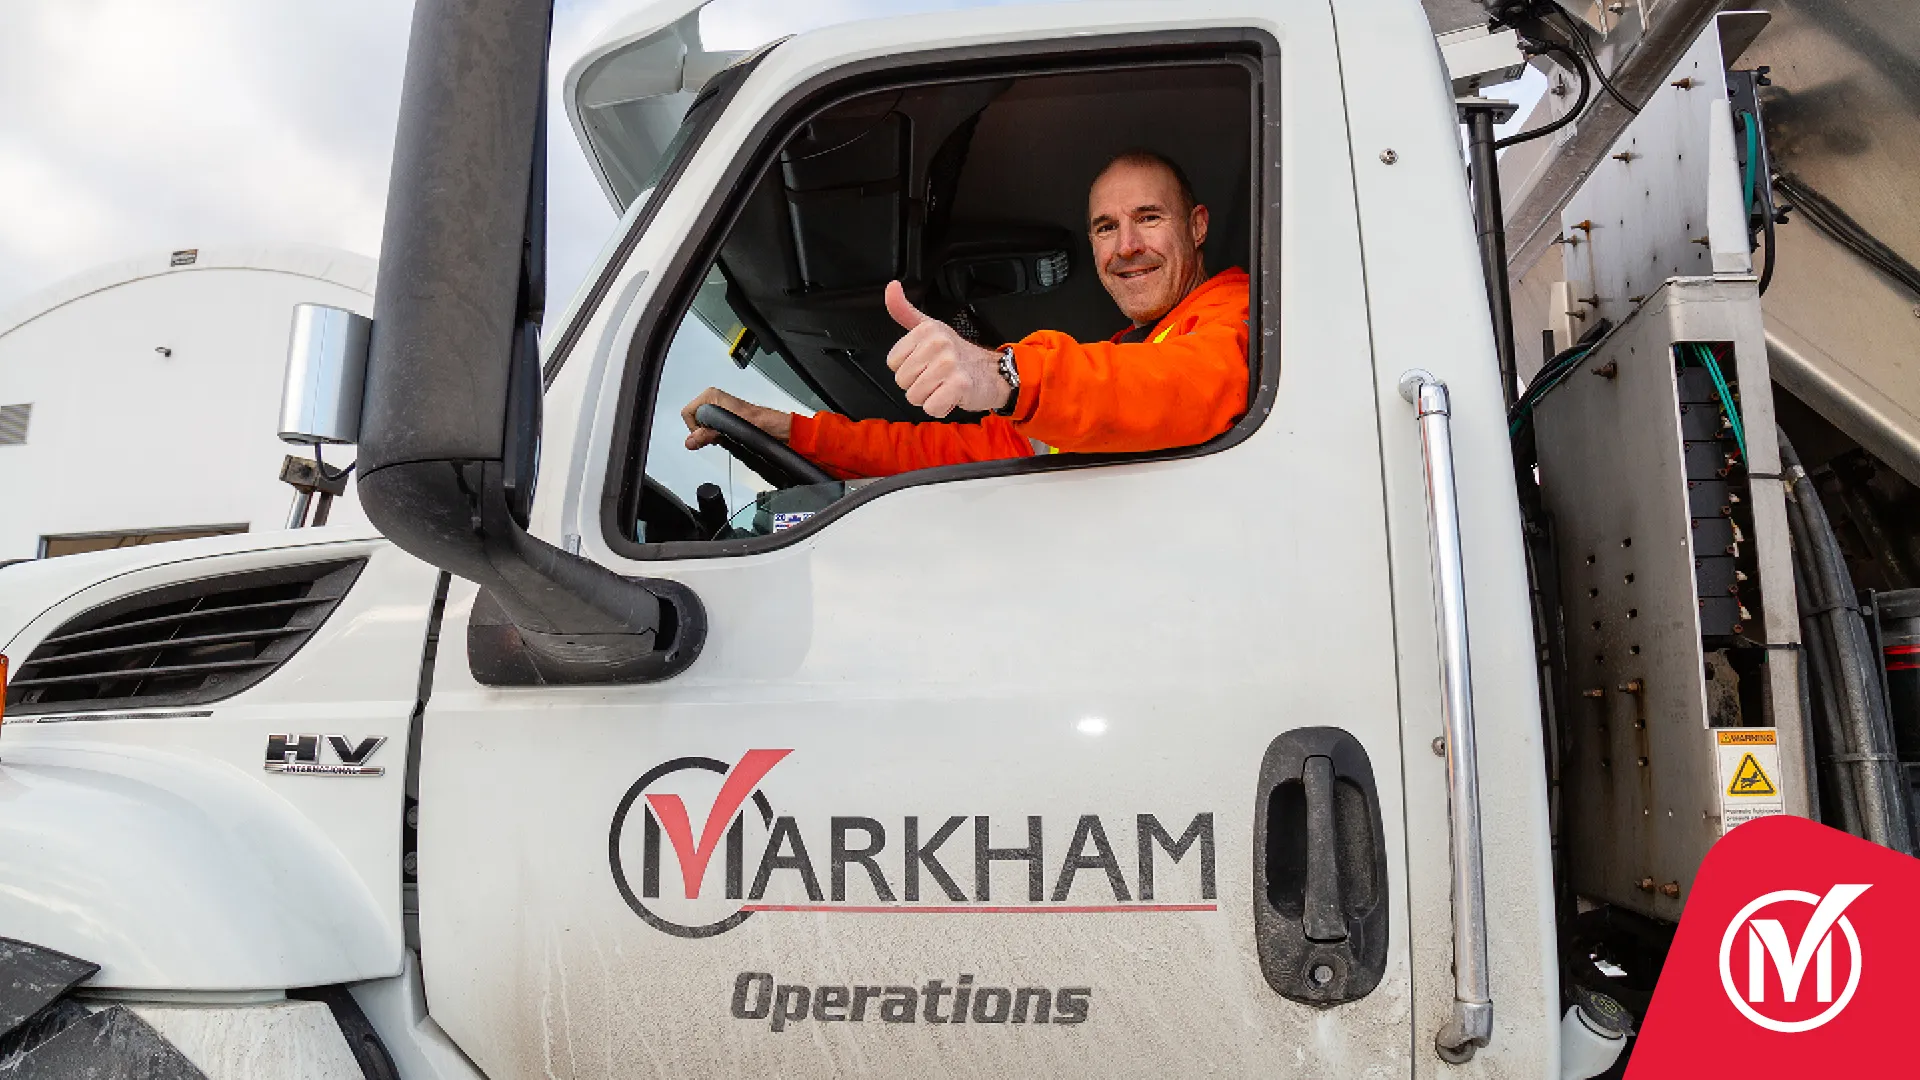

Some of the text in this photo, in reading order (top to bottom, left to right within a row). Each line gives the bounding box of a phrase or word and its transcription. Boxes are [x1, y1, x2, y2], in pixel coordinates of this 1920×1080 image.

[265, 733, 388, 765] HV
[1731, 733, 1774, 743] WARNING
[286, 765, 357, 775] INTERNATIONAL
[643, 749, 1217, 902] MARKHAM
[731, 972, 1092, 1033] Operations
